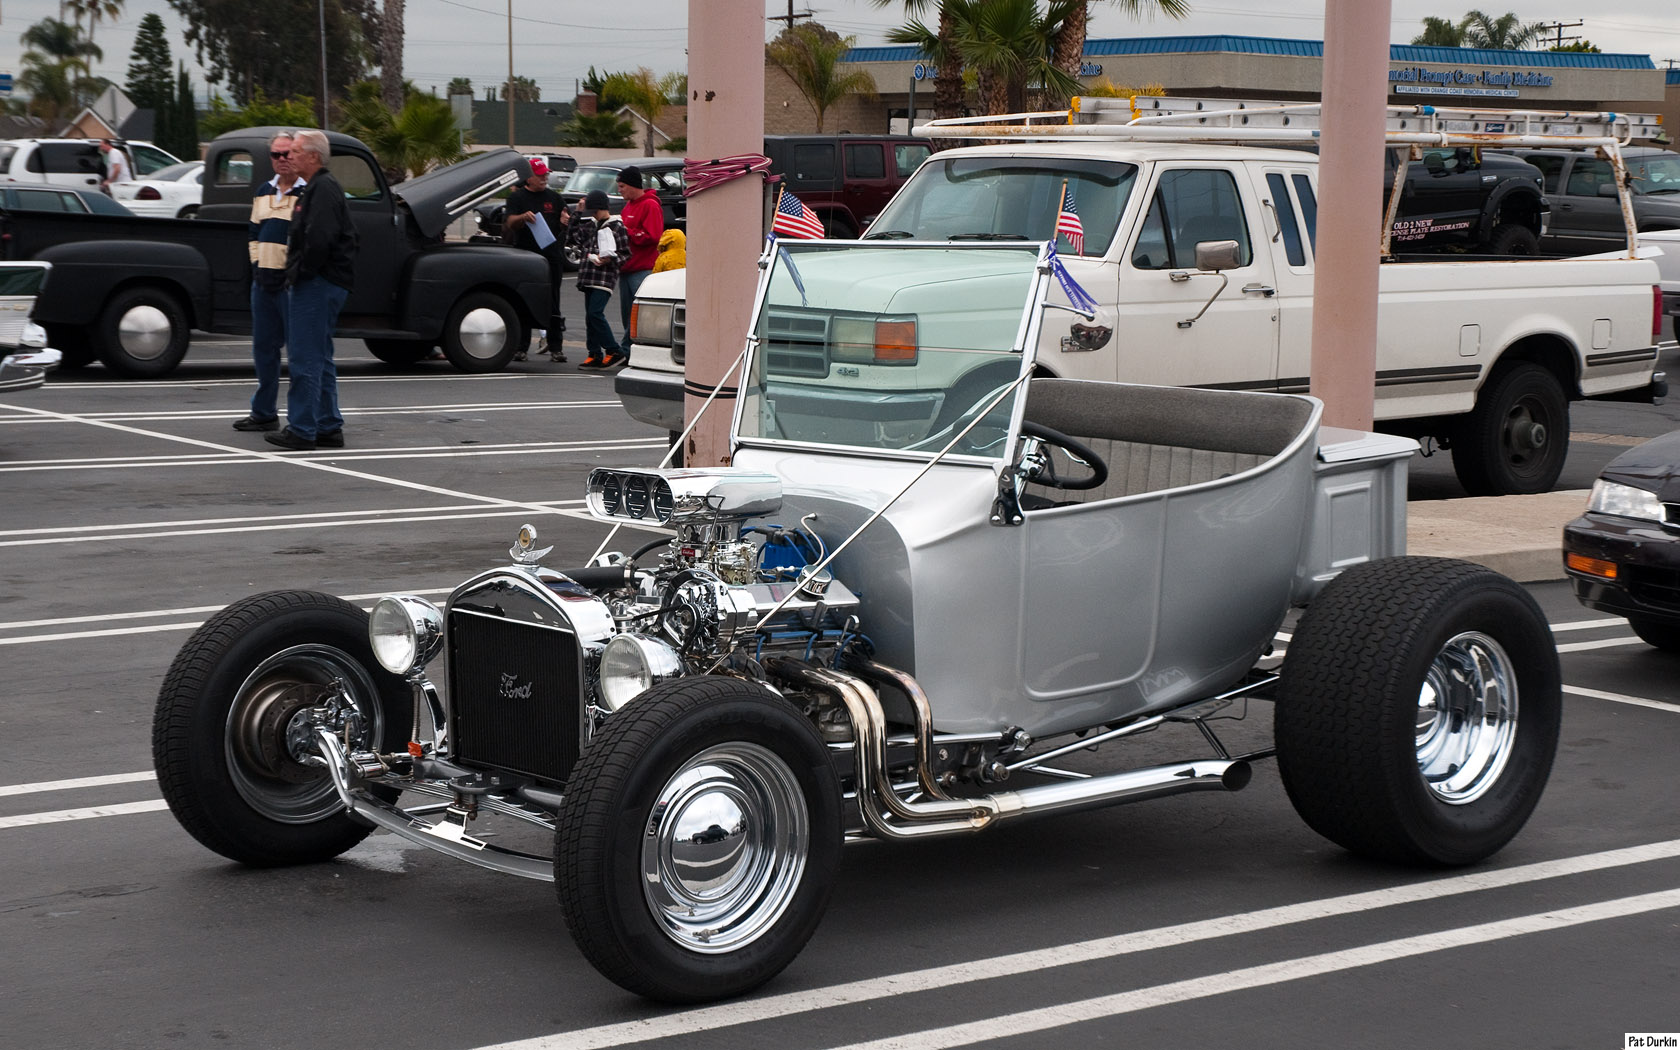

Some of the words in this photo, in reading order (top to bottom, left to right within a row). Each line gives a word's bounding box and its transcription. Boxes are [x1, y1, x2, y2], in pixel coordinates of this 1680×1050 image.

[1389, 67, 1418, 81] morial
[1420, 68, 1453, 86] Prompt
[1454, 69, 1476, 84] Care
[1483, 71, 1511, 88] Family
[1513, 72, 1553, 86] Medicine
[1394, 222, 1409, 230] OLD
[1415, 219, 1433, 227] NEW
[1430, 222, 1470, 232] RESTORATION
[500, 672, 532, 699] Ford
